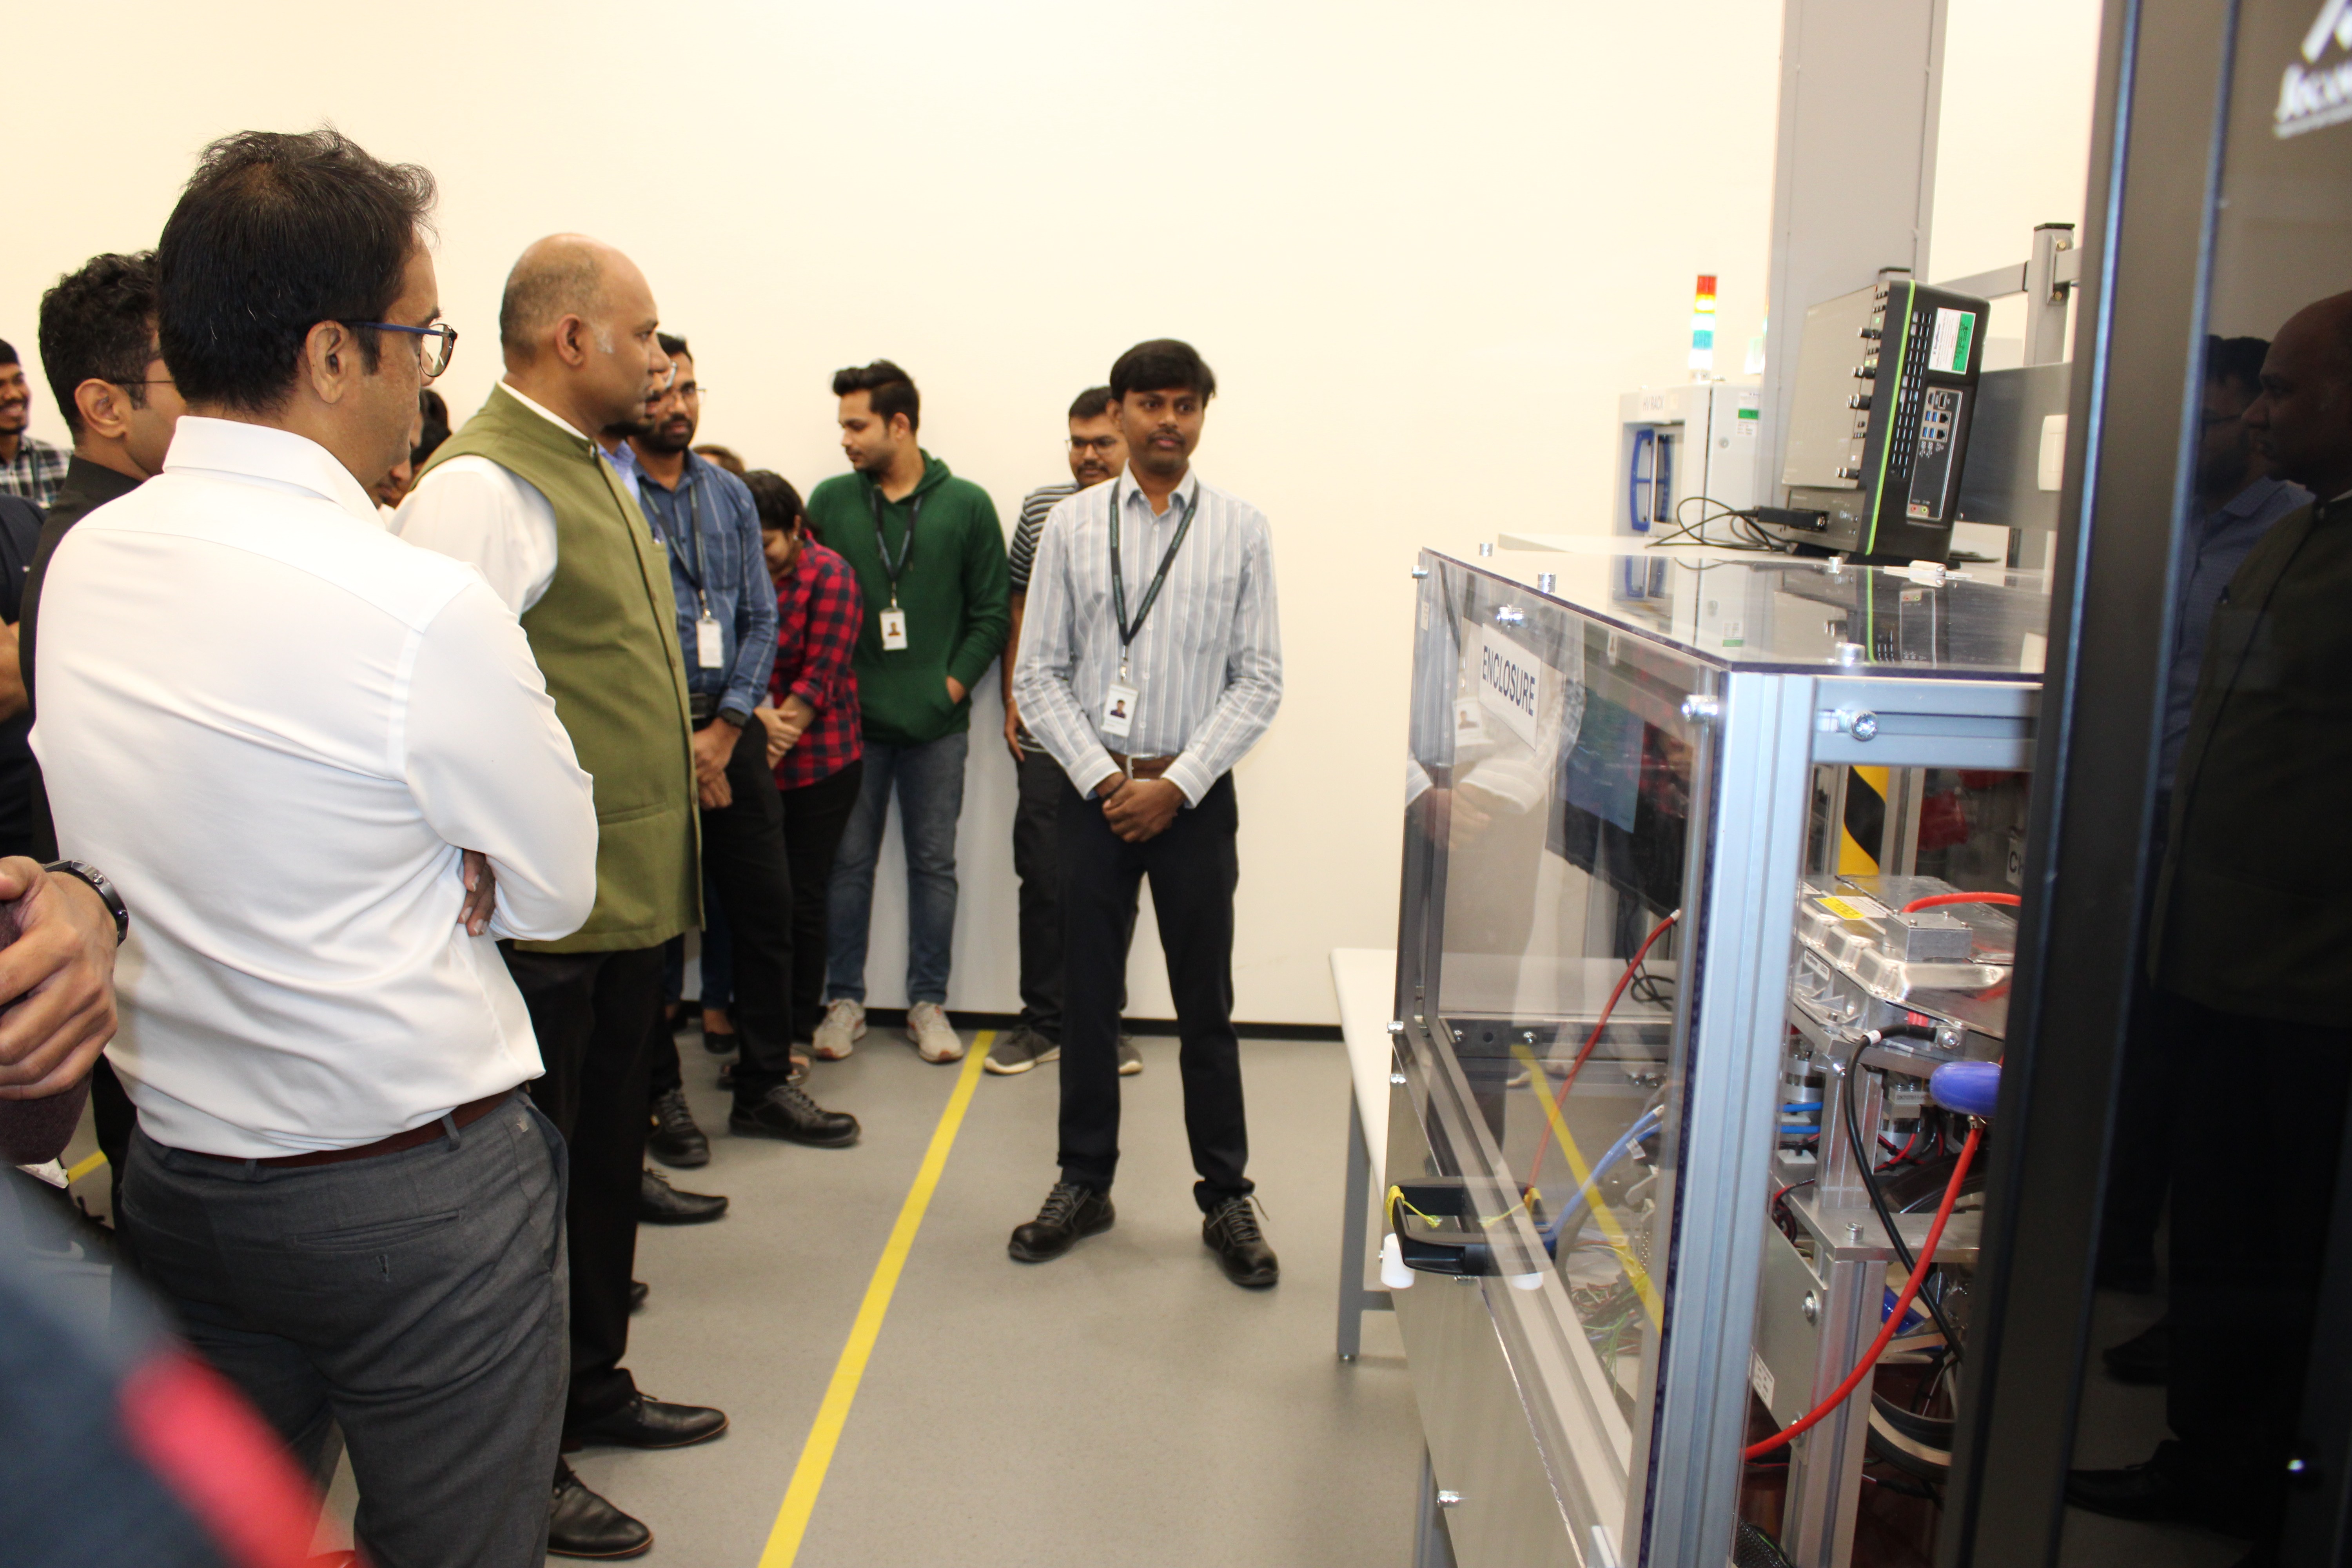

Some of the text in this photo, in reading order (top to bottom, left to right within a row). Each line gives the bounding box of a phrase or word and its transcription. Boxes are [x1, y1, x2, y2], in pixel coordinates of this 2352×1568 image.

[1642, 395, 1664, 411] HV RACK
[1483, 645, 1535, 716] ENCLOSURE
